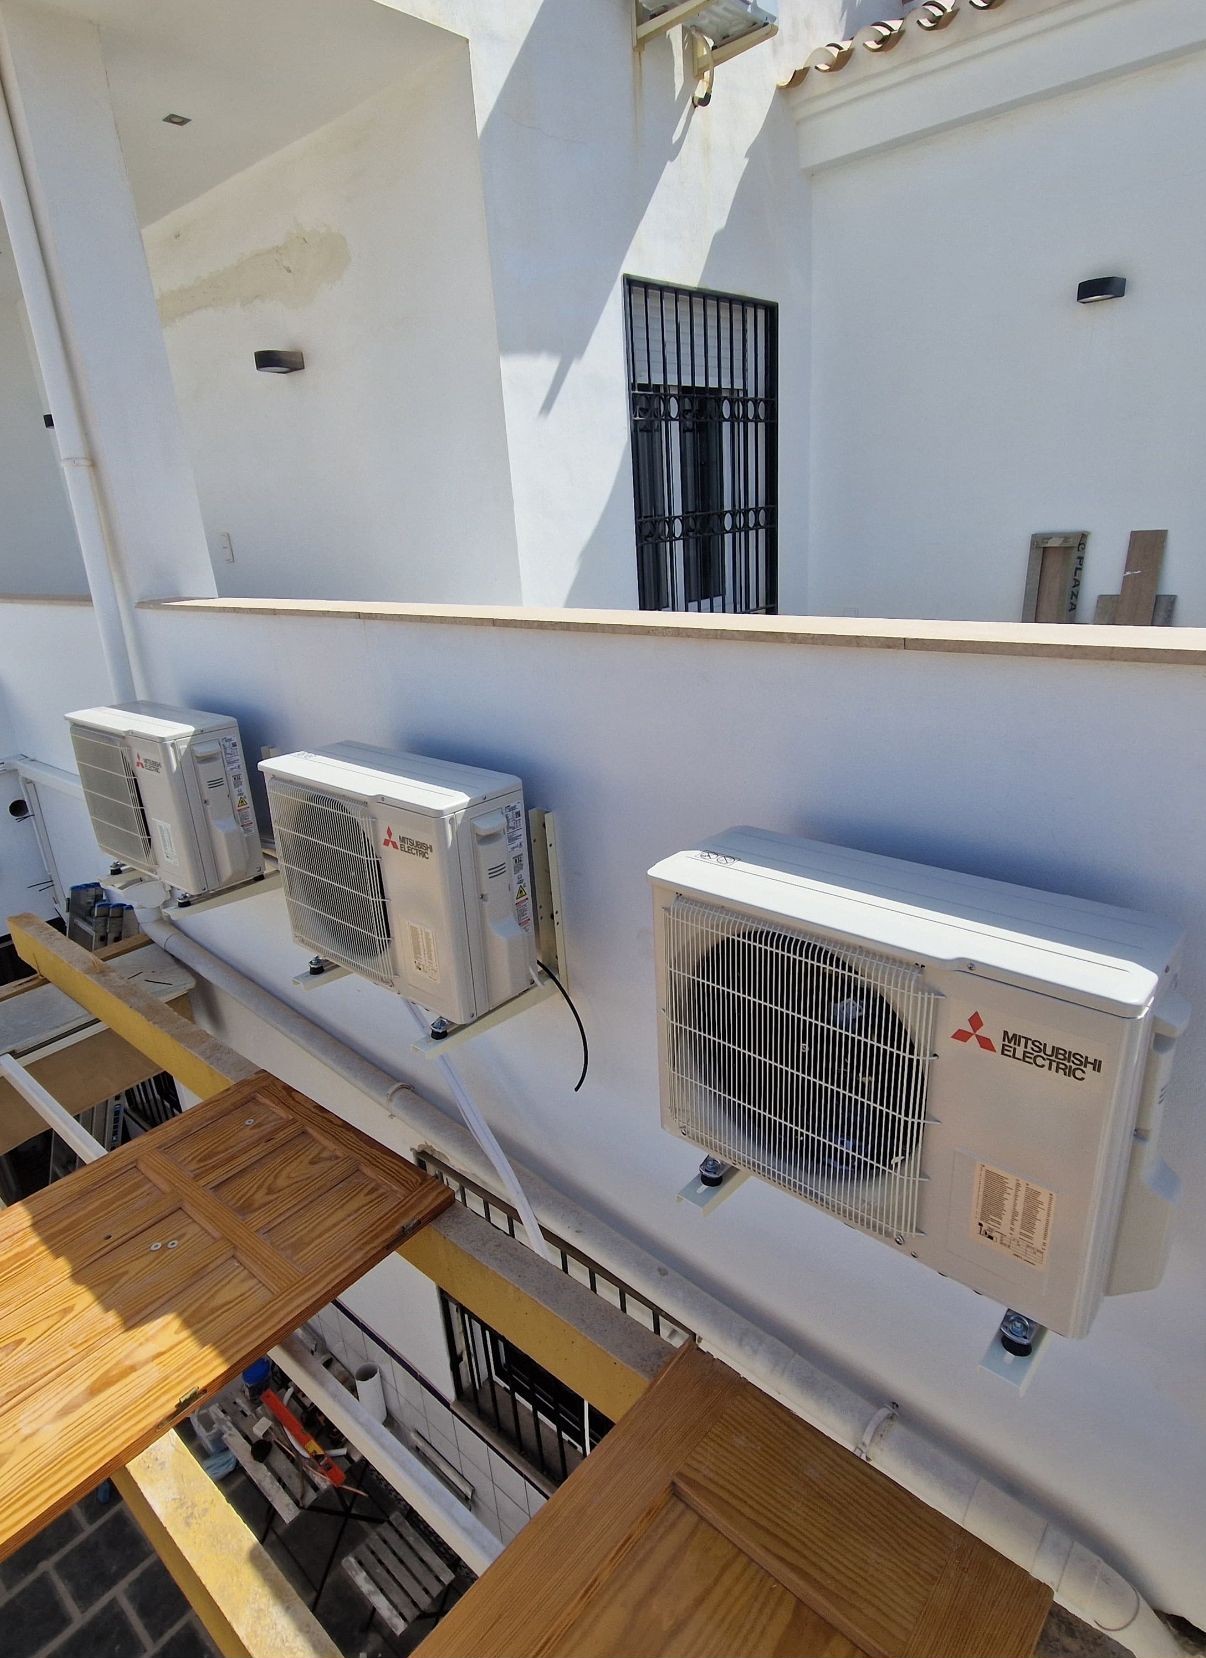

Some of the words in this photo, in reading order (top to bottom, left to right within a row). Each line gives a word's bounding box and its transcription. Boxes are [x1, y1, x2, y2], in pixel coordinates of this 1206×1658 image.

[1068, 556, 1084, 613] PLAZA
[400, 843, 430, 860] ELECTRIC
[1000, 1043, 1086, 1082] ELECTRIC
[1002, 1030, 1102, 1073] MITSUBISHI
